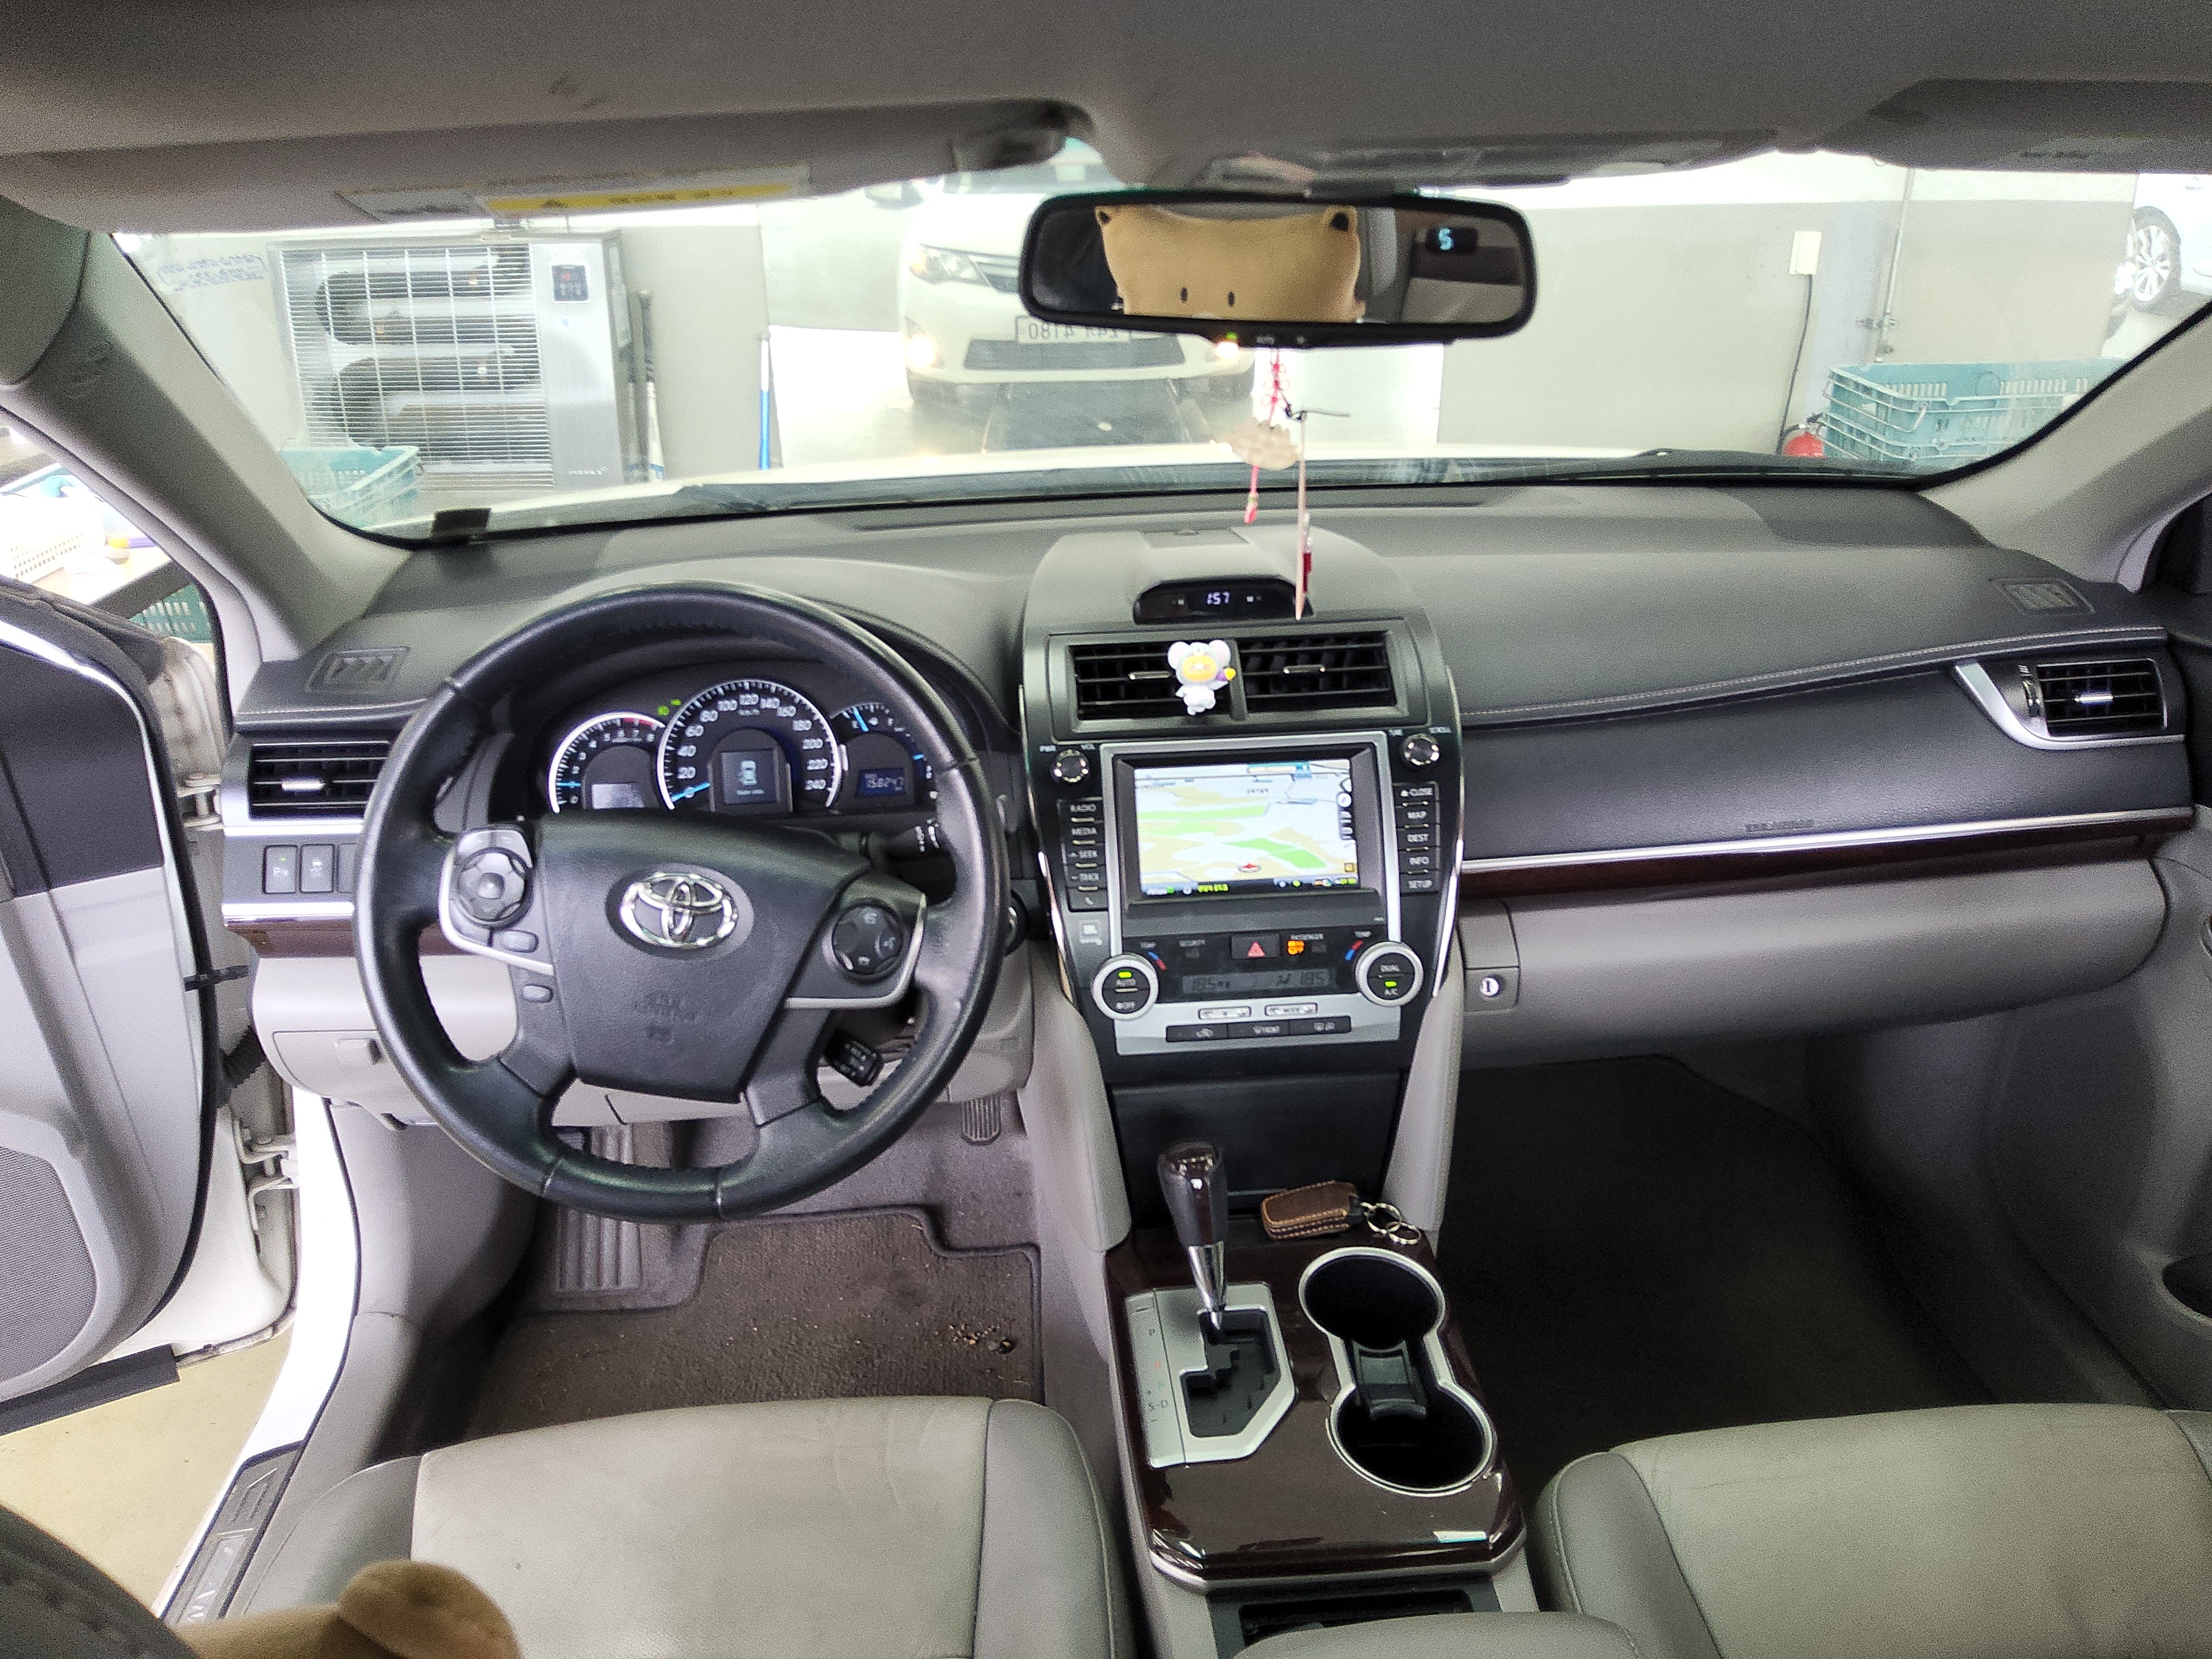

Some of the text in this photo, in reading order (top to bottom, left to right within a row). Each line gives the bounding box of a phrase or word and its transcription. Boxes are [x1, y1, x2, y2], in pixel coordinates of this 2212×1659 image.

[1439, 227, 1452, 250] S
[739, 694, 759, 705] 120
[760, 698, 780, 708] 140
[718, 700, 737, 711] 100
[700, 710, 718, 722] 80
[777, 706, 797, 717] 160
[793, 720, 812, 731] 180
[685, 726, 704, 737] 60
[803, 738, 823, 750] 200
[677, 745, 696, 757] 40
[806, 759, 828, 770] 220
[678, 767, 696, 779] 20
[805, 779, 826, 790] 240
[1070, 804, 1096, 812] RADIO
[1407, 811, 1427, 819] MAP
[1072, 827, 1097, 835] MEDIA
[1407, 834, 1429, 842] DEST
[1078, 850, 1098, 858] SEEK
[1408, 880, 1433, 889] SETUP
[1116, 978, 1136, 987] AUTO
